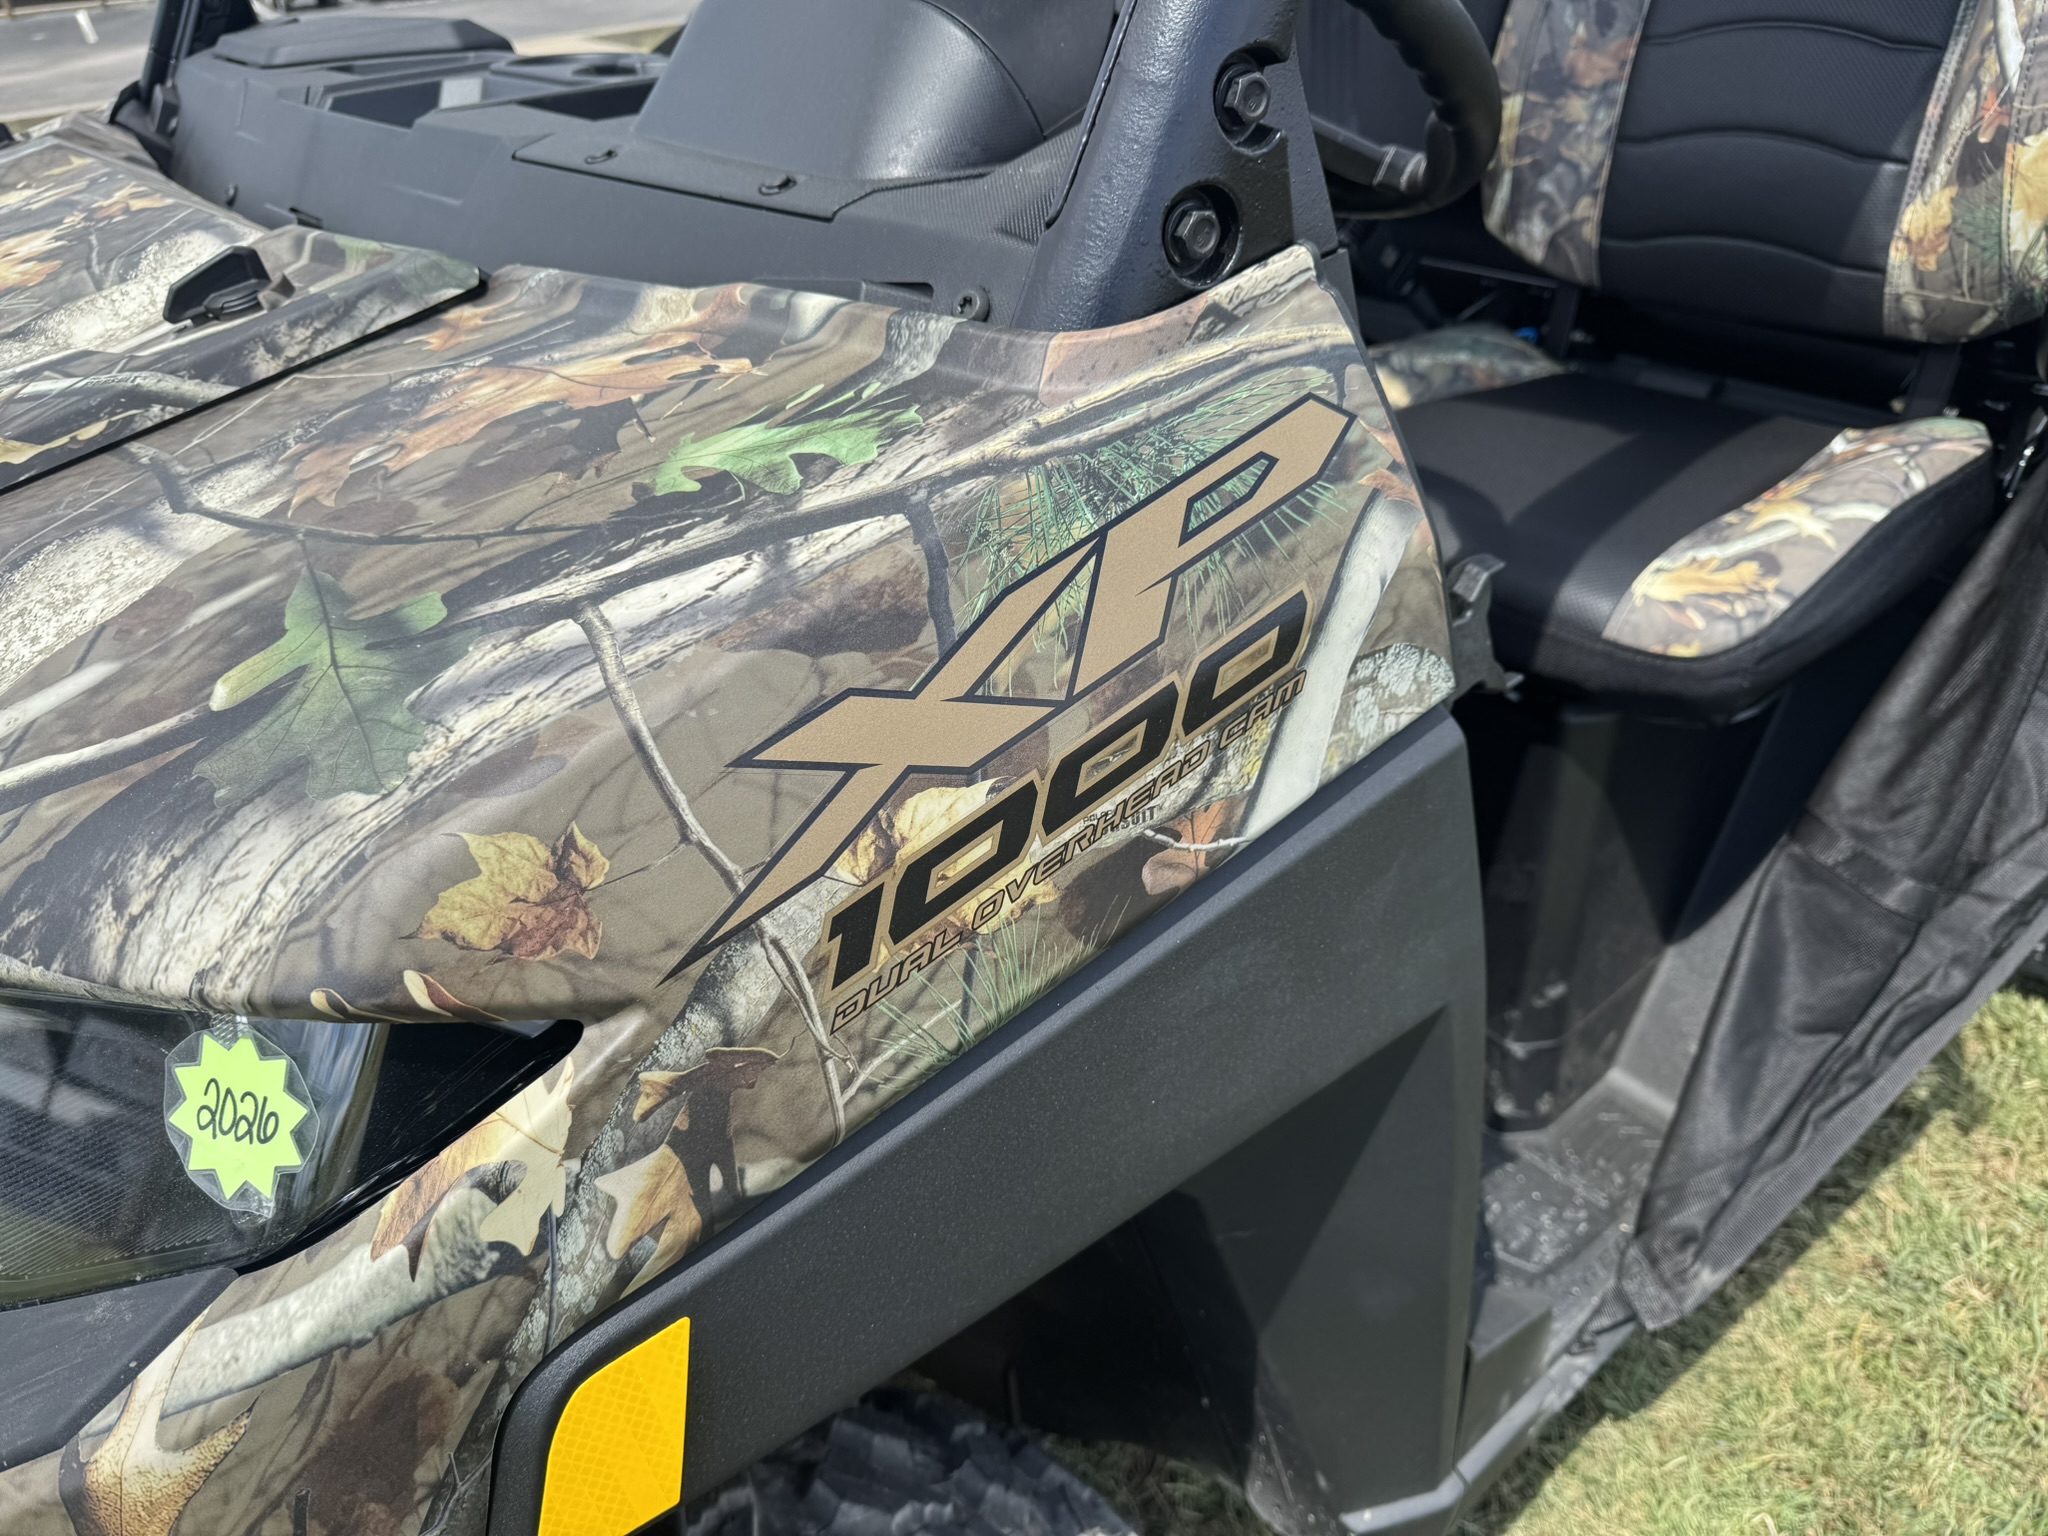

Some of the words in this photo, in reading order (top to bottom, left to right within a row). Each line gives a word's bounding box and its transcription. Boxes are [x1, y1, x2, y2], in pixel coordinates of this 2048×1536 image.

[656, 392, 1356, 988] XP
[822, 583, 1312, 997] 1000
[830, 927, 963, 1036] DUAL
[972, 739, 1211, 931] OVERHEAD
[1218, 669, 1308, 750] CAM
[196, 1077, 280, 1145] 2026
